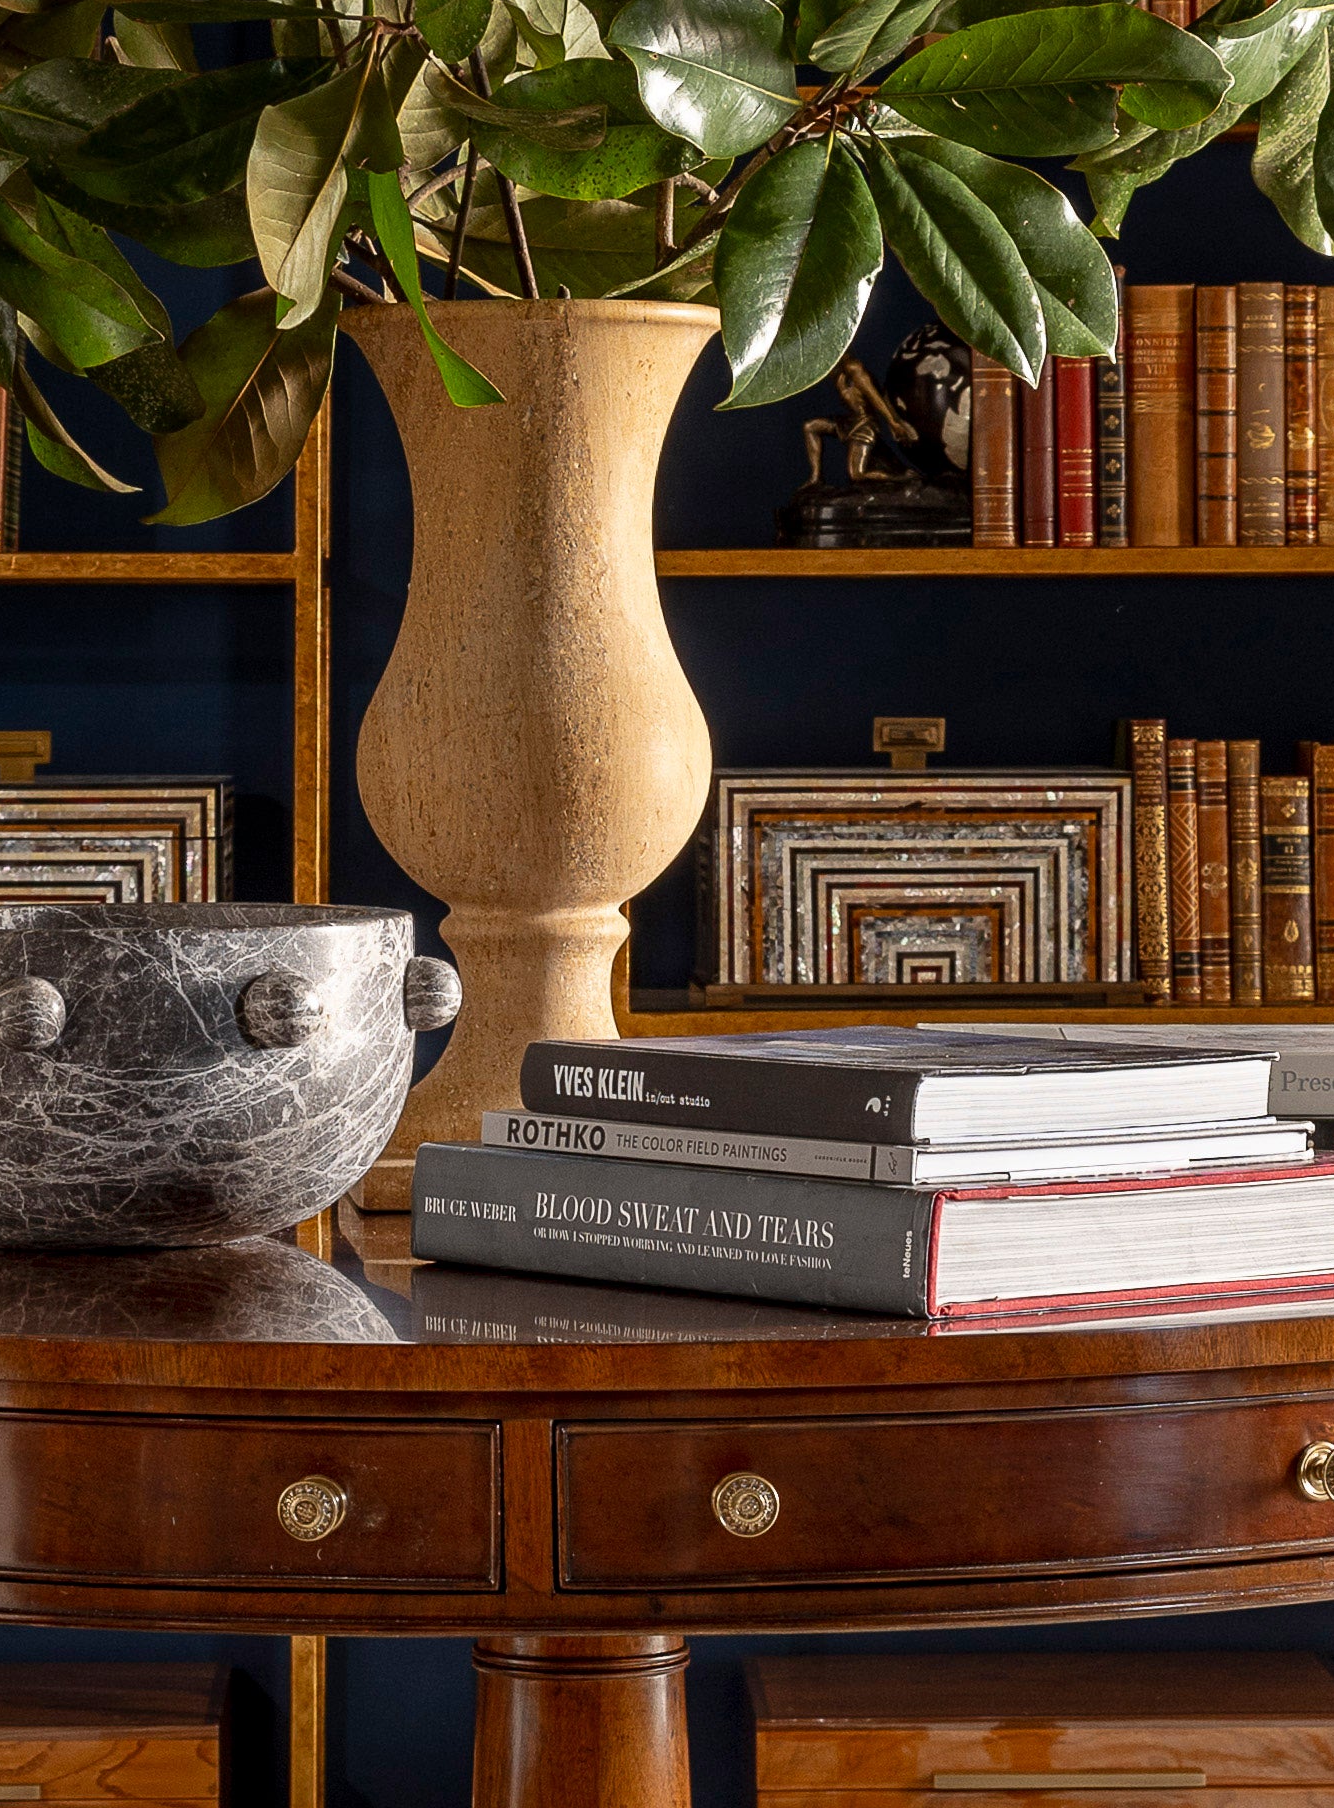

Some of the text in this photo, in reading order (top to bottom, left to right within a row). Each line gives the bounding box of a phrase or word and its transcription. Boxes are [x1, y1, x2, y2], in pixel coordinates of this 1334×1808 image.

[553, 1064, 711, 1108] YVES KLEIN in/out studio
[506, 1116, 788, 1163] ROTHKO THE COLOR FIELD PAINTINGS
[424, 1196, 517, 1223] BRUCE WEBER
[535, 1192, 835, 1250] BLOOD SWEAT AND TEARS
[533, 1227, 546, 1239] OR
[549, 1228, 570, 1242] HOW
[578, 1232, 621, 1247] STOPPED
[622, 1236, 673, 1253] WORRYING
[676, 1241, 695, 1255] AND
[697, 1244, 742, 1261] LEARNED
[745, 1249, 759, 1262] TO
[761, 1252, 787, 1266] LOVE
[789, 1255, 833, 1270] FASHION
